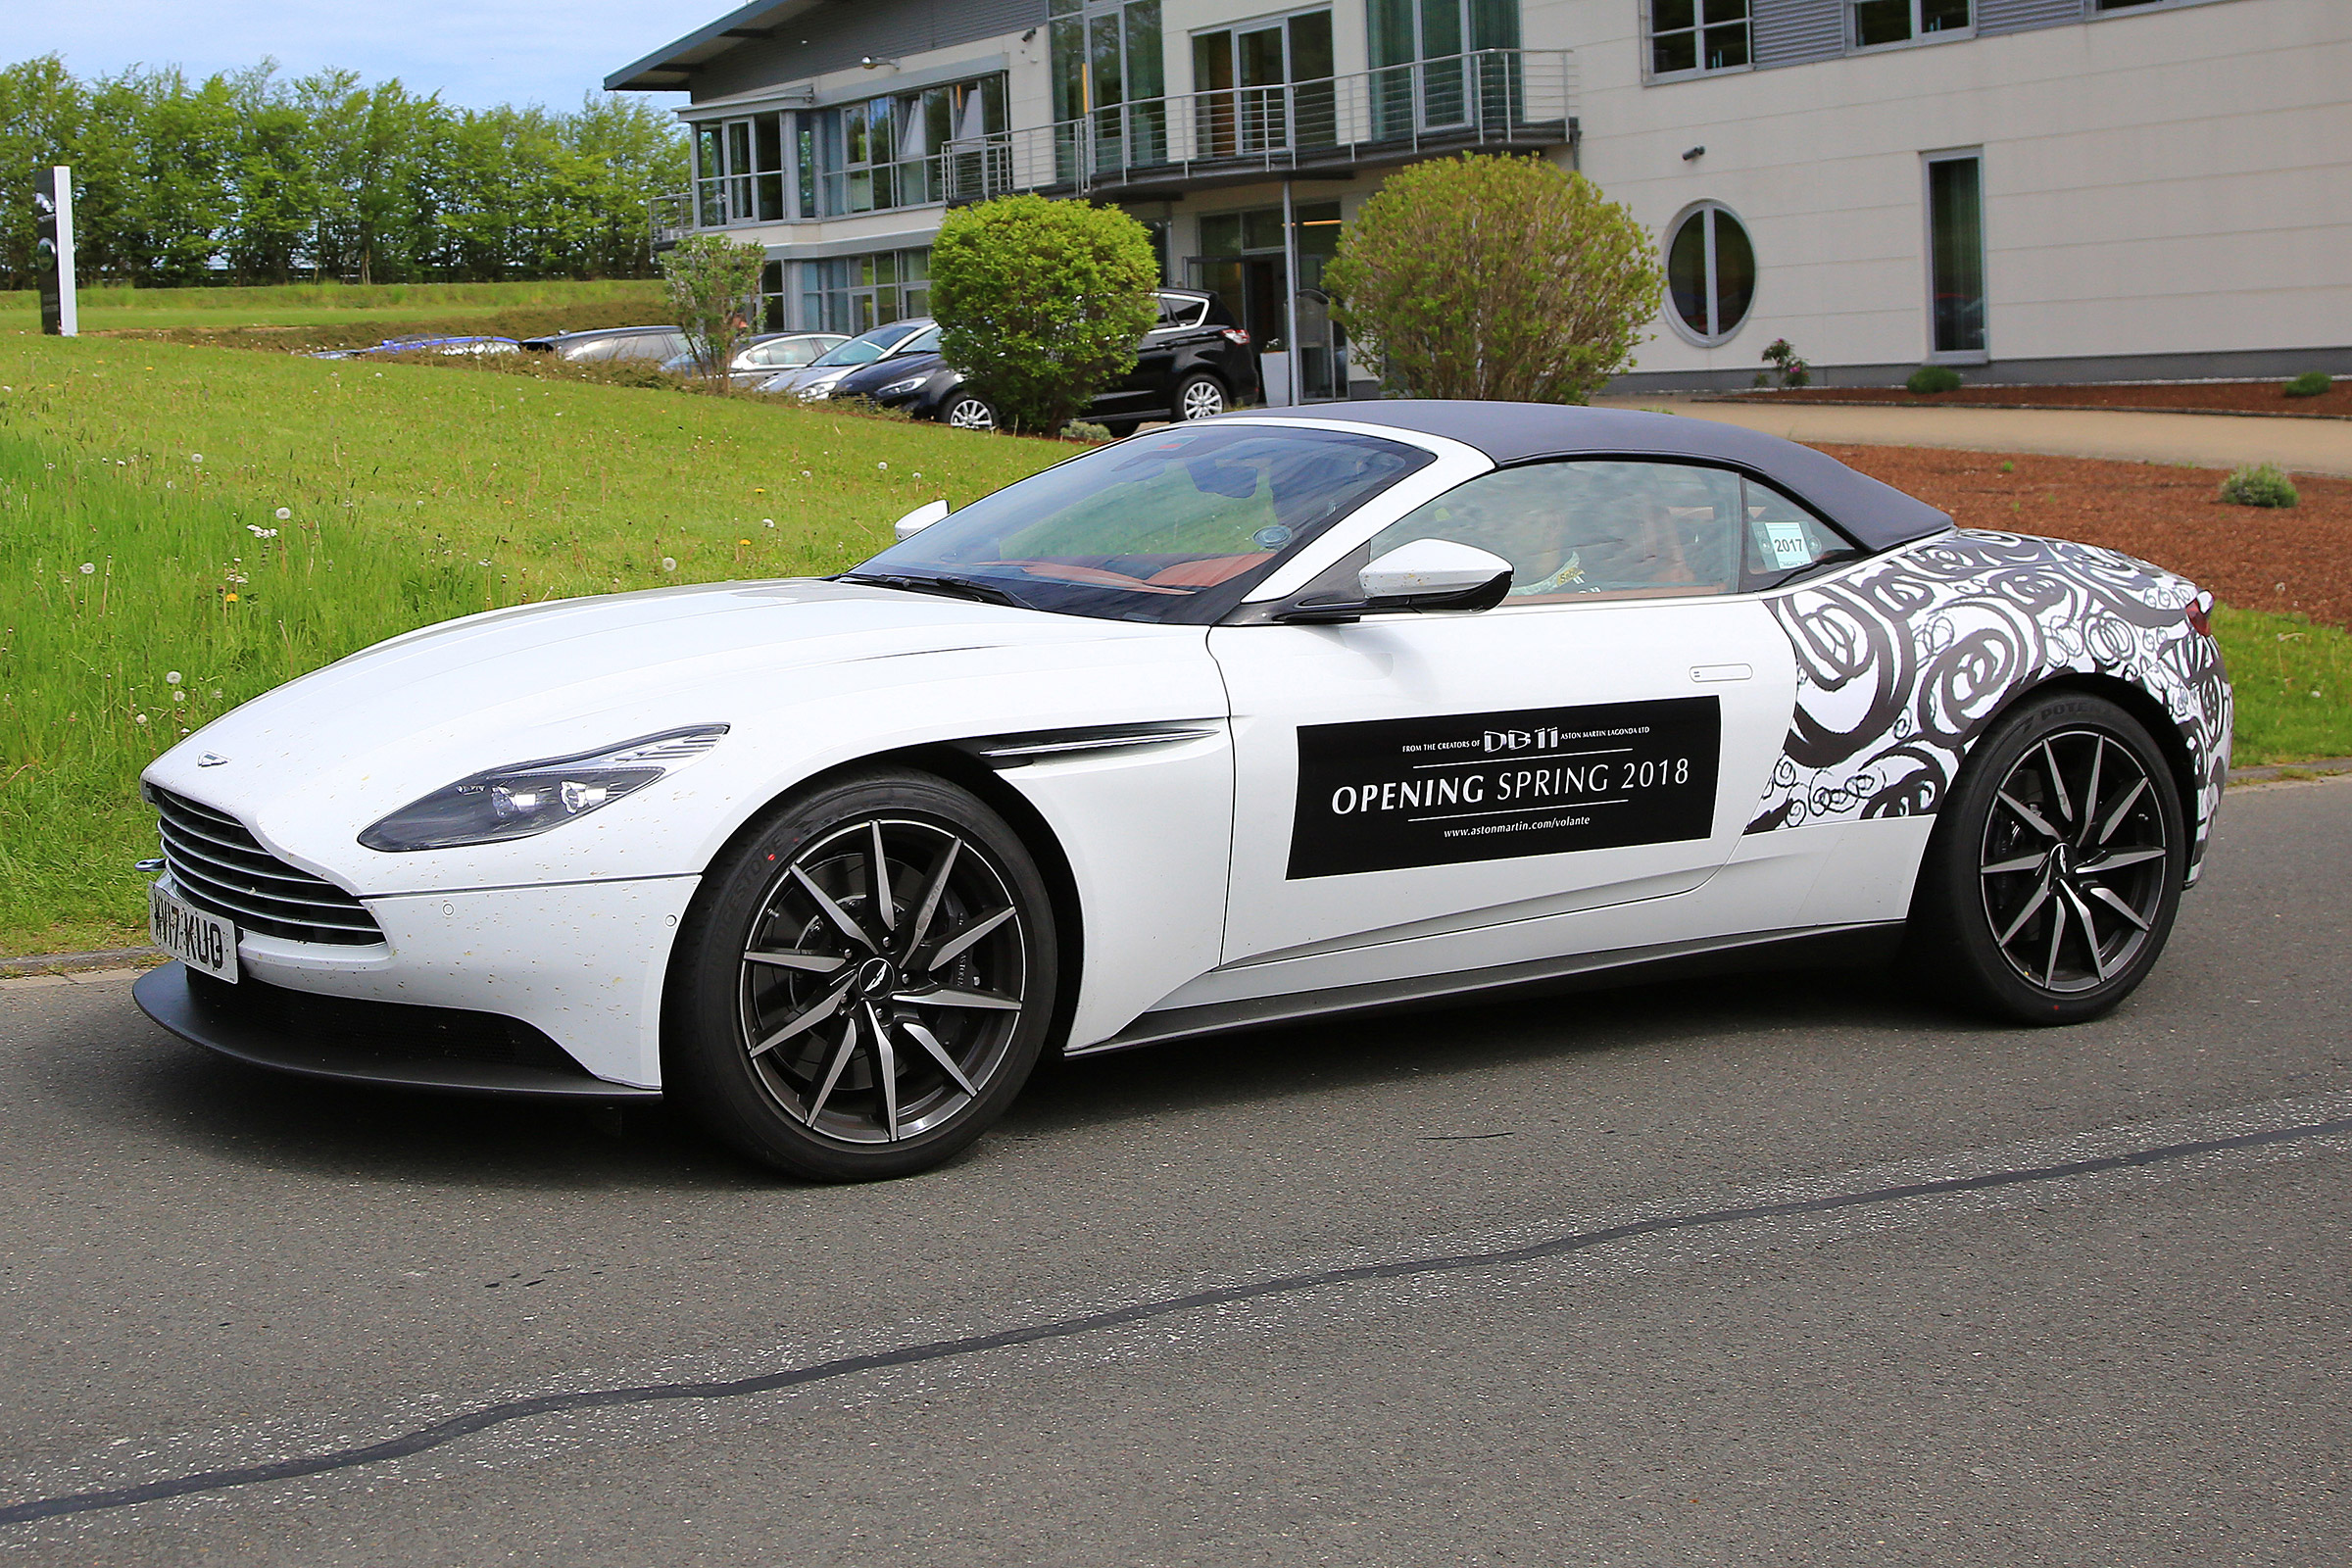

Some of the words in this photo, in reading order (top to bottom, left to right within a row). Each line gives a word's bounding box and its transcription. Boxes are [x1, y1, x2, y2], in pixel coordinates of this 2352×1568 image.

[1774, 538, 1802, 553] 2017
[1438, 740, 1470, 750] CREATORS
[1583, 729, 1606, 738] MARTIN
[1332, 775, 1484, 814] OPENING
[1496, 763, 1609, 801] SPRING
[1620, 758, 1689, 789] 2018
[1444, 815, 1591, 838] www.astonmartin.com/volante
